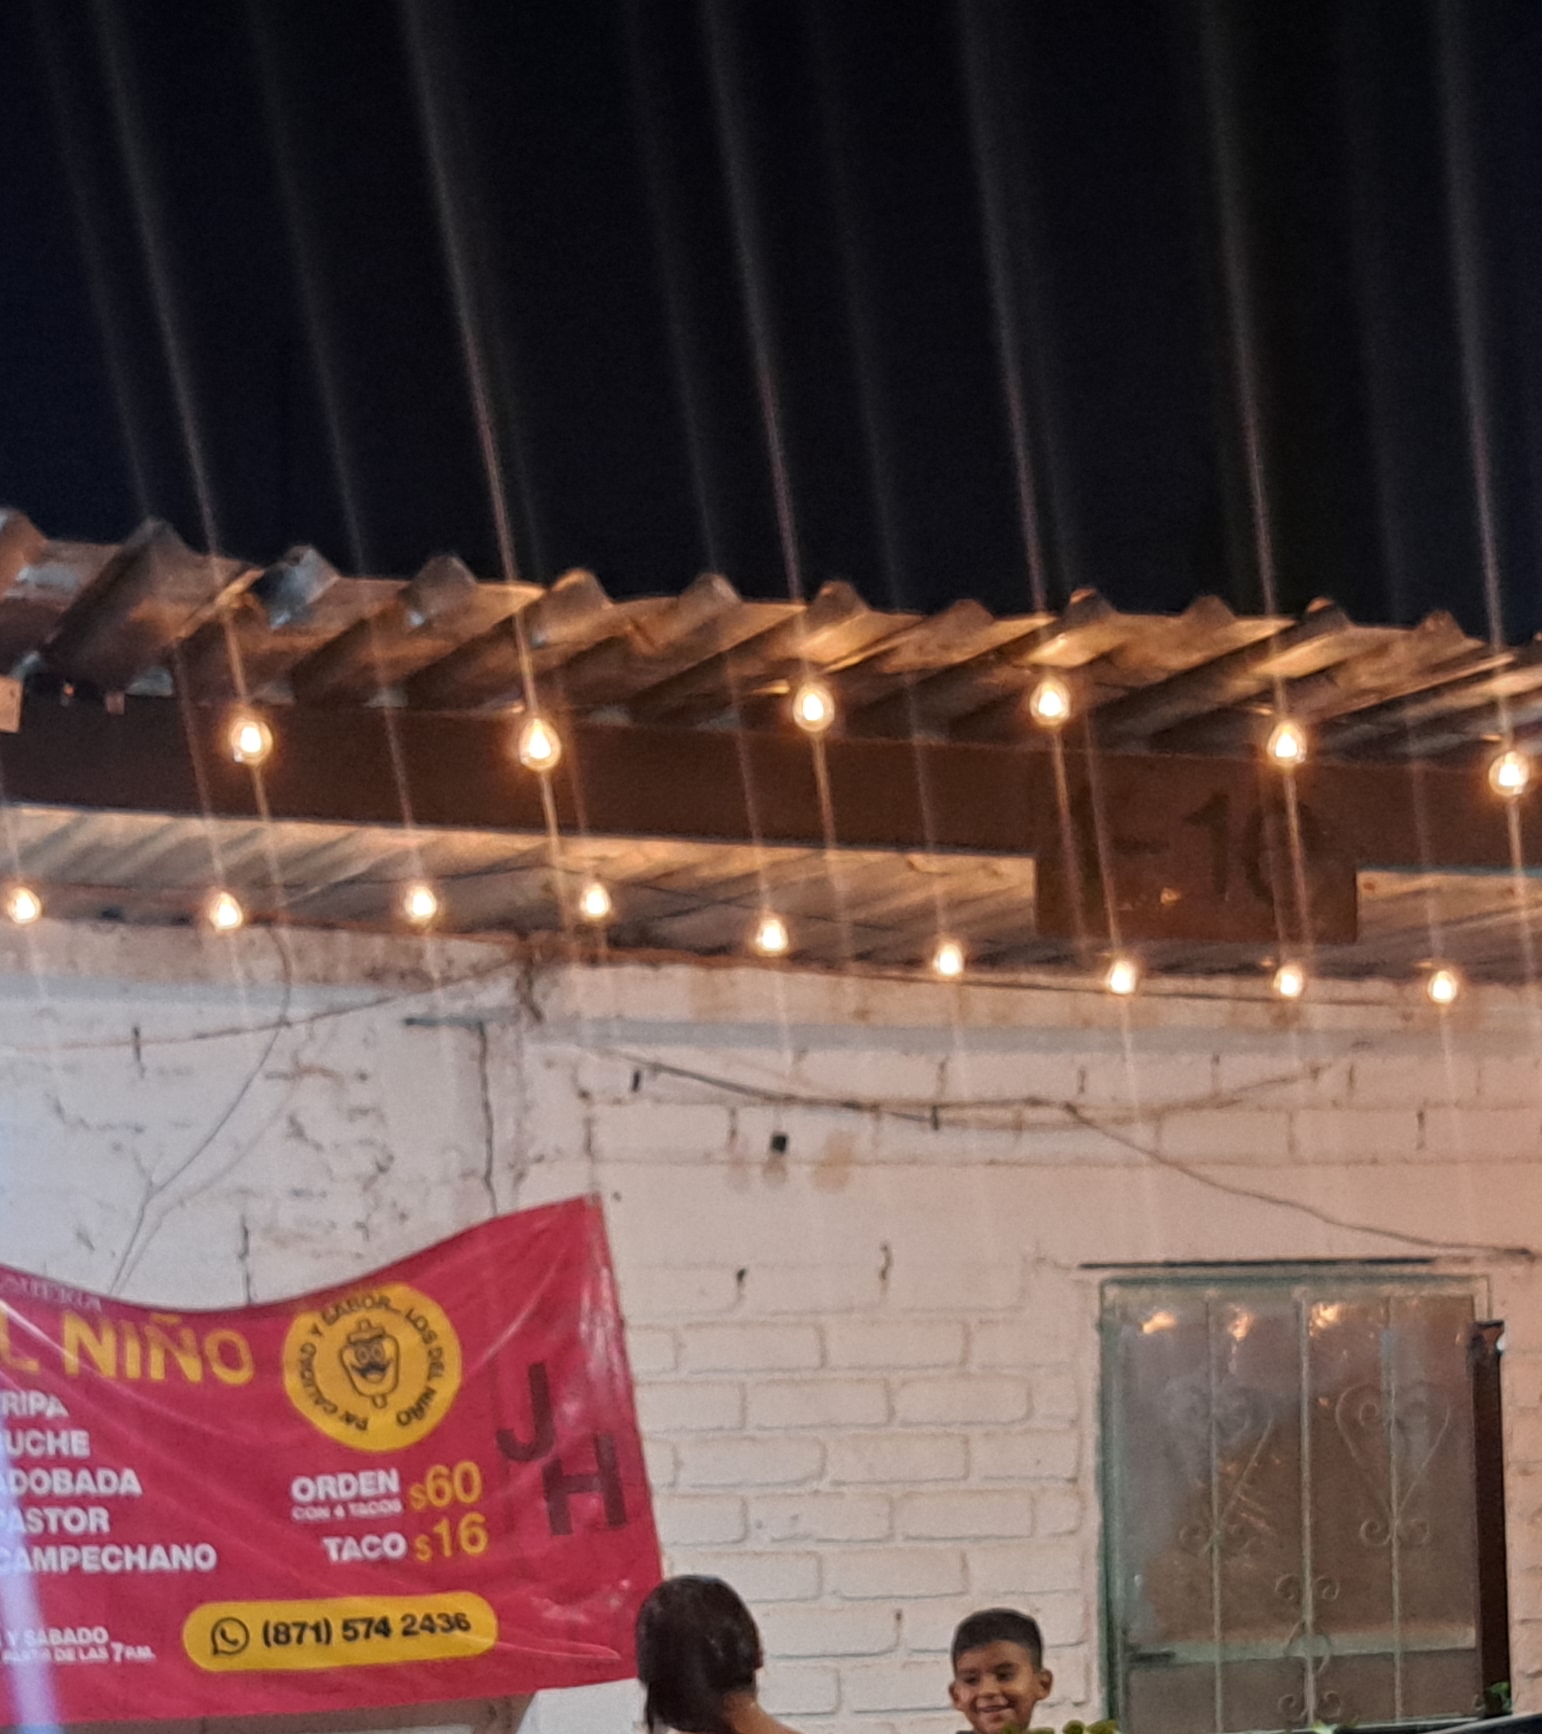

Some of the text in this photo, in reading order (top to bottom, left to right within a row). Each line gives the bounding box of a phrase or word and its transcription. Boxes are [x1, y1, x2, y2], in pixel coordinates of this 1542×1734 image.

[63, 1309, 253, 1385] NIÑO
[291, 1460, 482, 1511] ORDEN $60
[322, 1511, 488, 1564] TACO $16
[78, 1645, 109, 1661] LAS
[262, 1612, 472, 1648] (871) 574 2436
